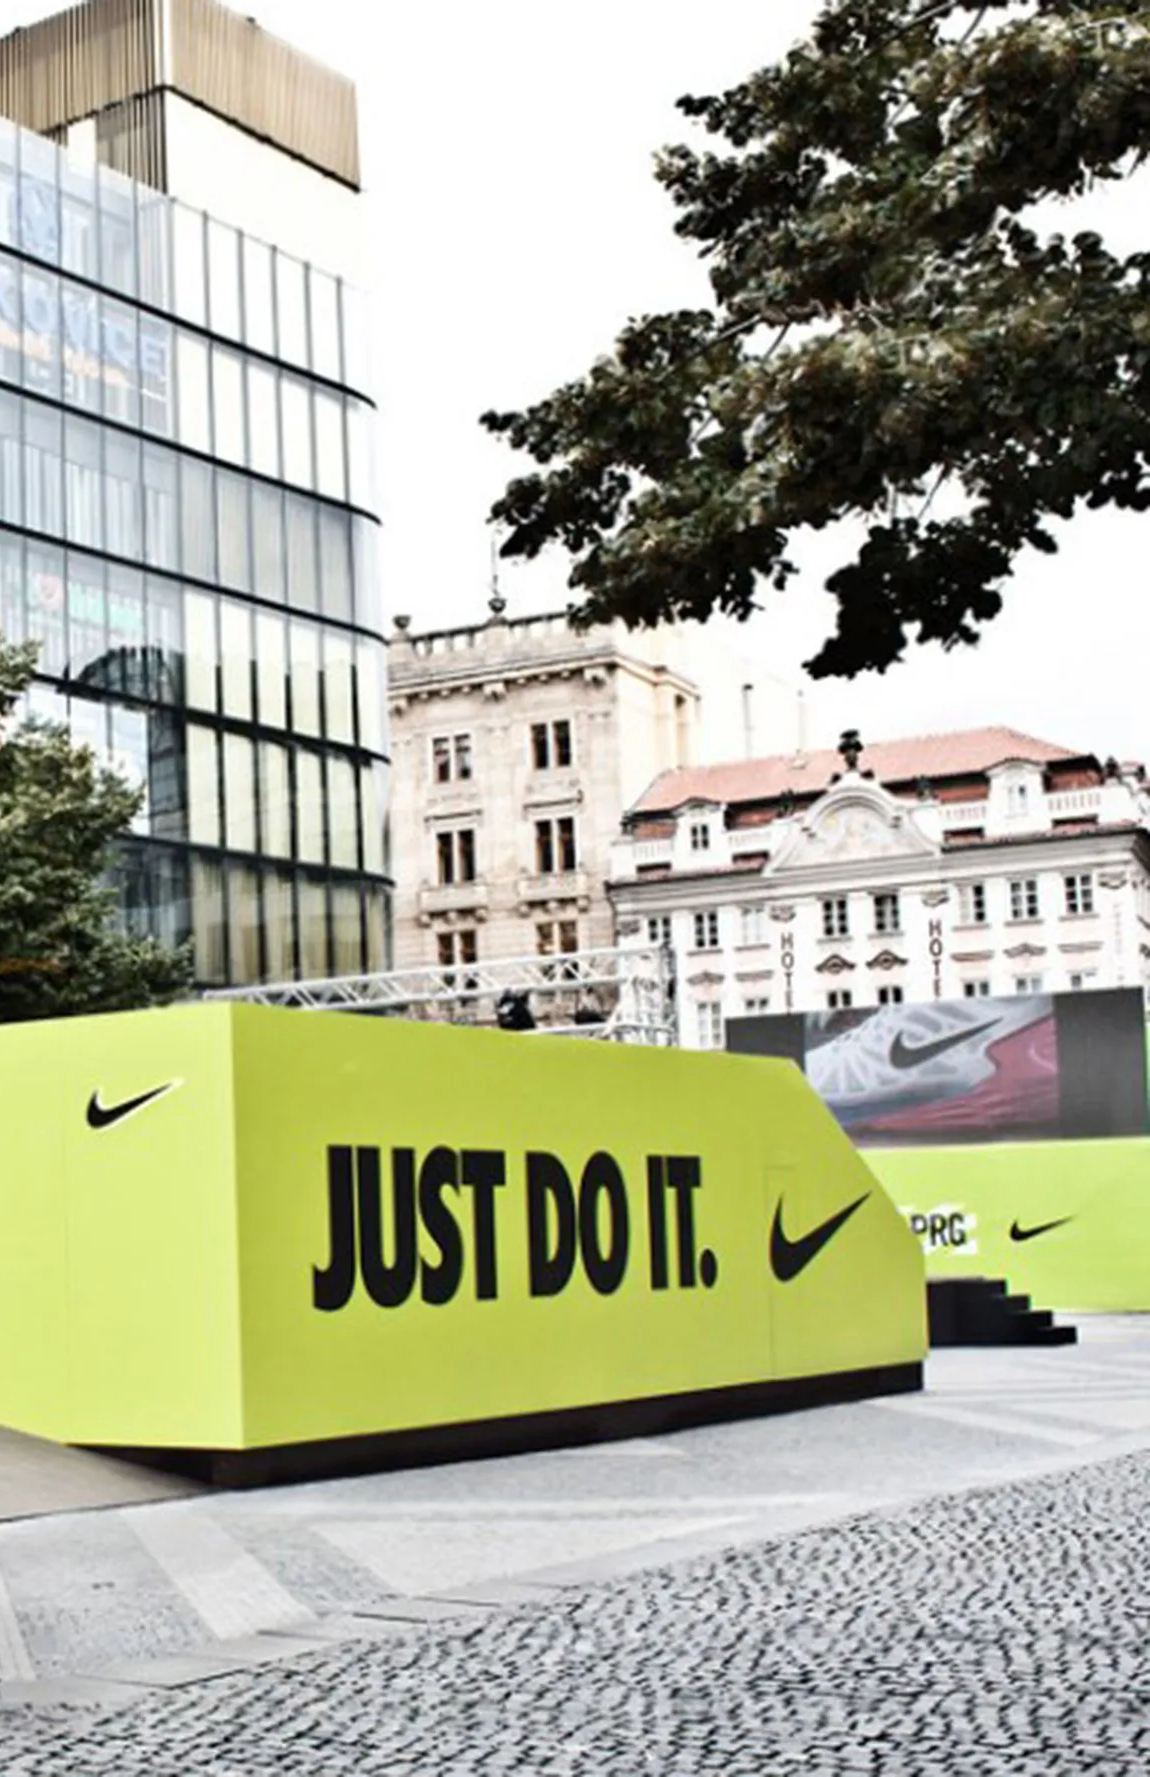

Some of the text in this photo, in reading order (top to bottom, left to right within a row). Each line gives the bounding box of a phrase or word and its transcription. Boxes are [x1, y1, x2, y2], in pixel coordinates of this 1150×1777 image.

[313, 1145, 718, 1312] JUST DO IT.
[911, 1213, 967, 1247] PRG
